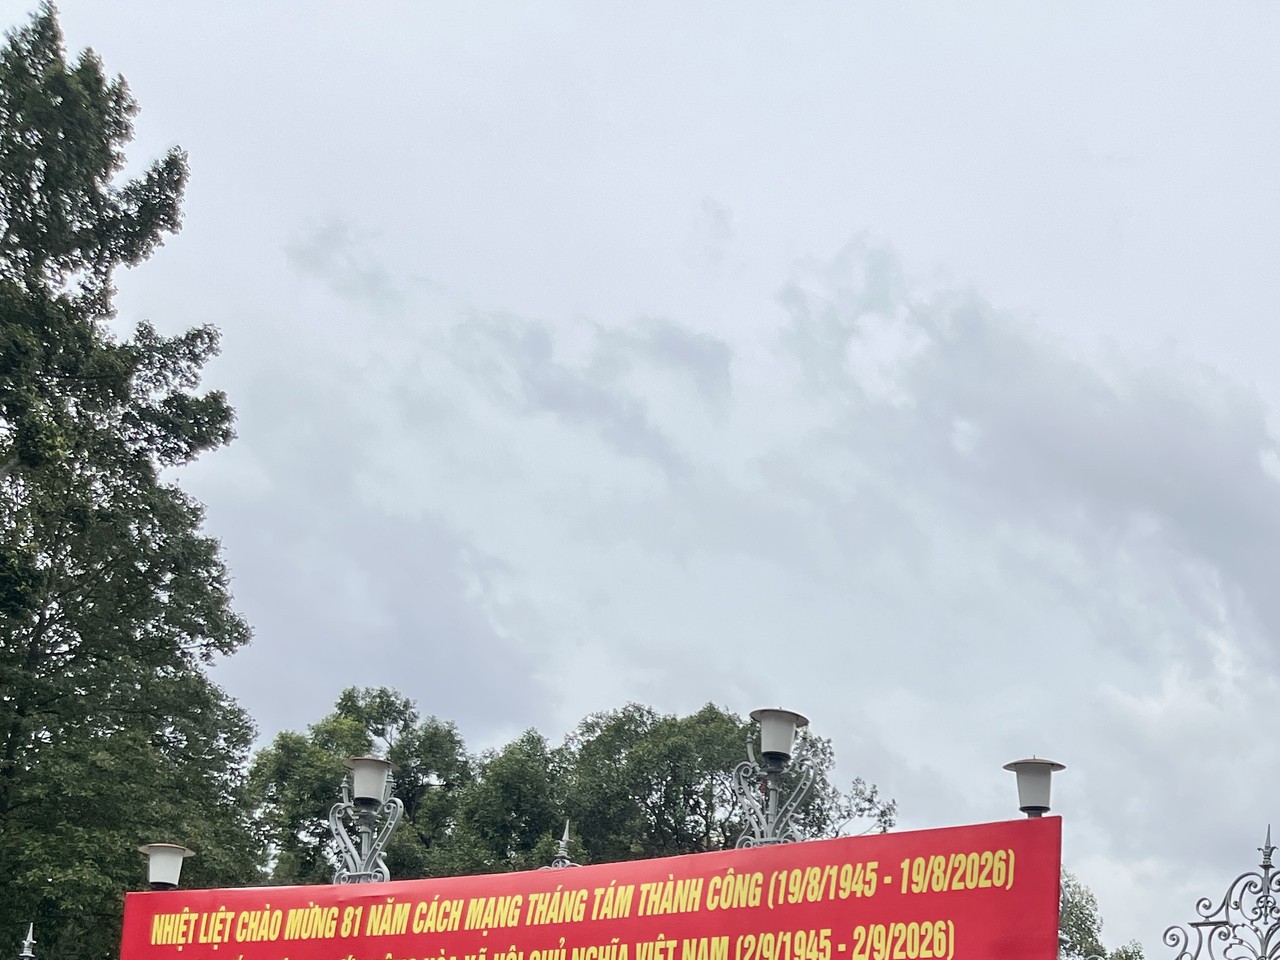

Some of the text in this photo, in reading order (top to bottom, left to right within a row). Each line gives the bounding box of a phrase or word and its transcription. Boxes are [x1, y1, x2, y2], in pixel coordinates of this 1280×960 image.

[151, 848, 1015, 951] NHIỆT LIỆT CHÀO MỪNG 81 NĂM CÁCH MẠNG THÁNG TÁM THÀNH CÔNG (19/8/1945 - 19/8/2026)
[838, 943, 847, 952] -
